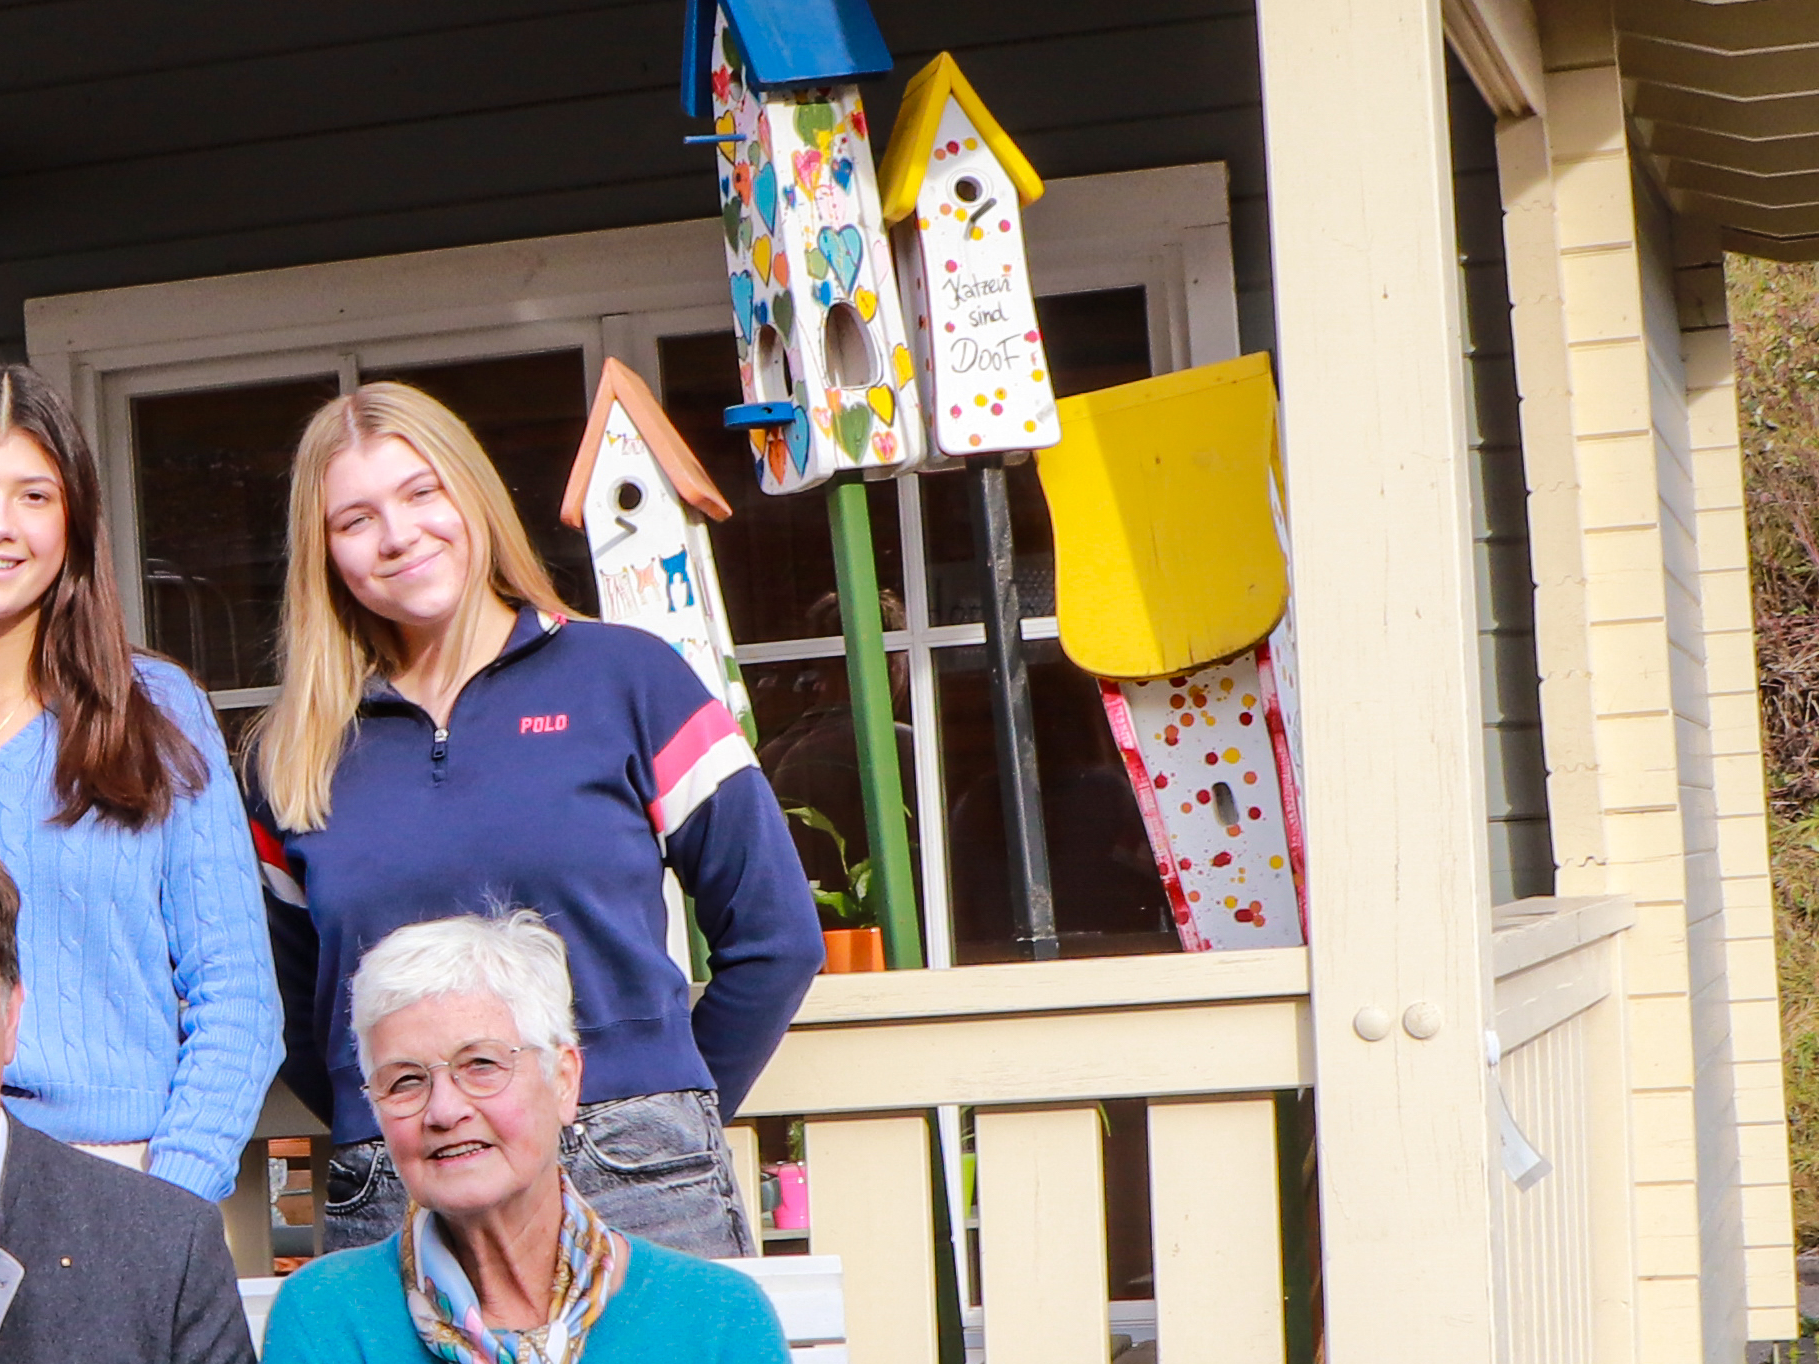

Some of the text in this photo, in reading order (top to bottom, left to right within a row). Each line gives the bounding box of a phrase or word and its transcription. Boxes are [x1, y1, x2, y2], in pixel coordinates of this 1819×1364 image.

[941, 273, 1013, 310] Katzen
[968, 301, 1010, 328] sind
[519, 713, 569, 734] POLO
